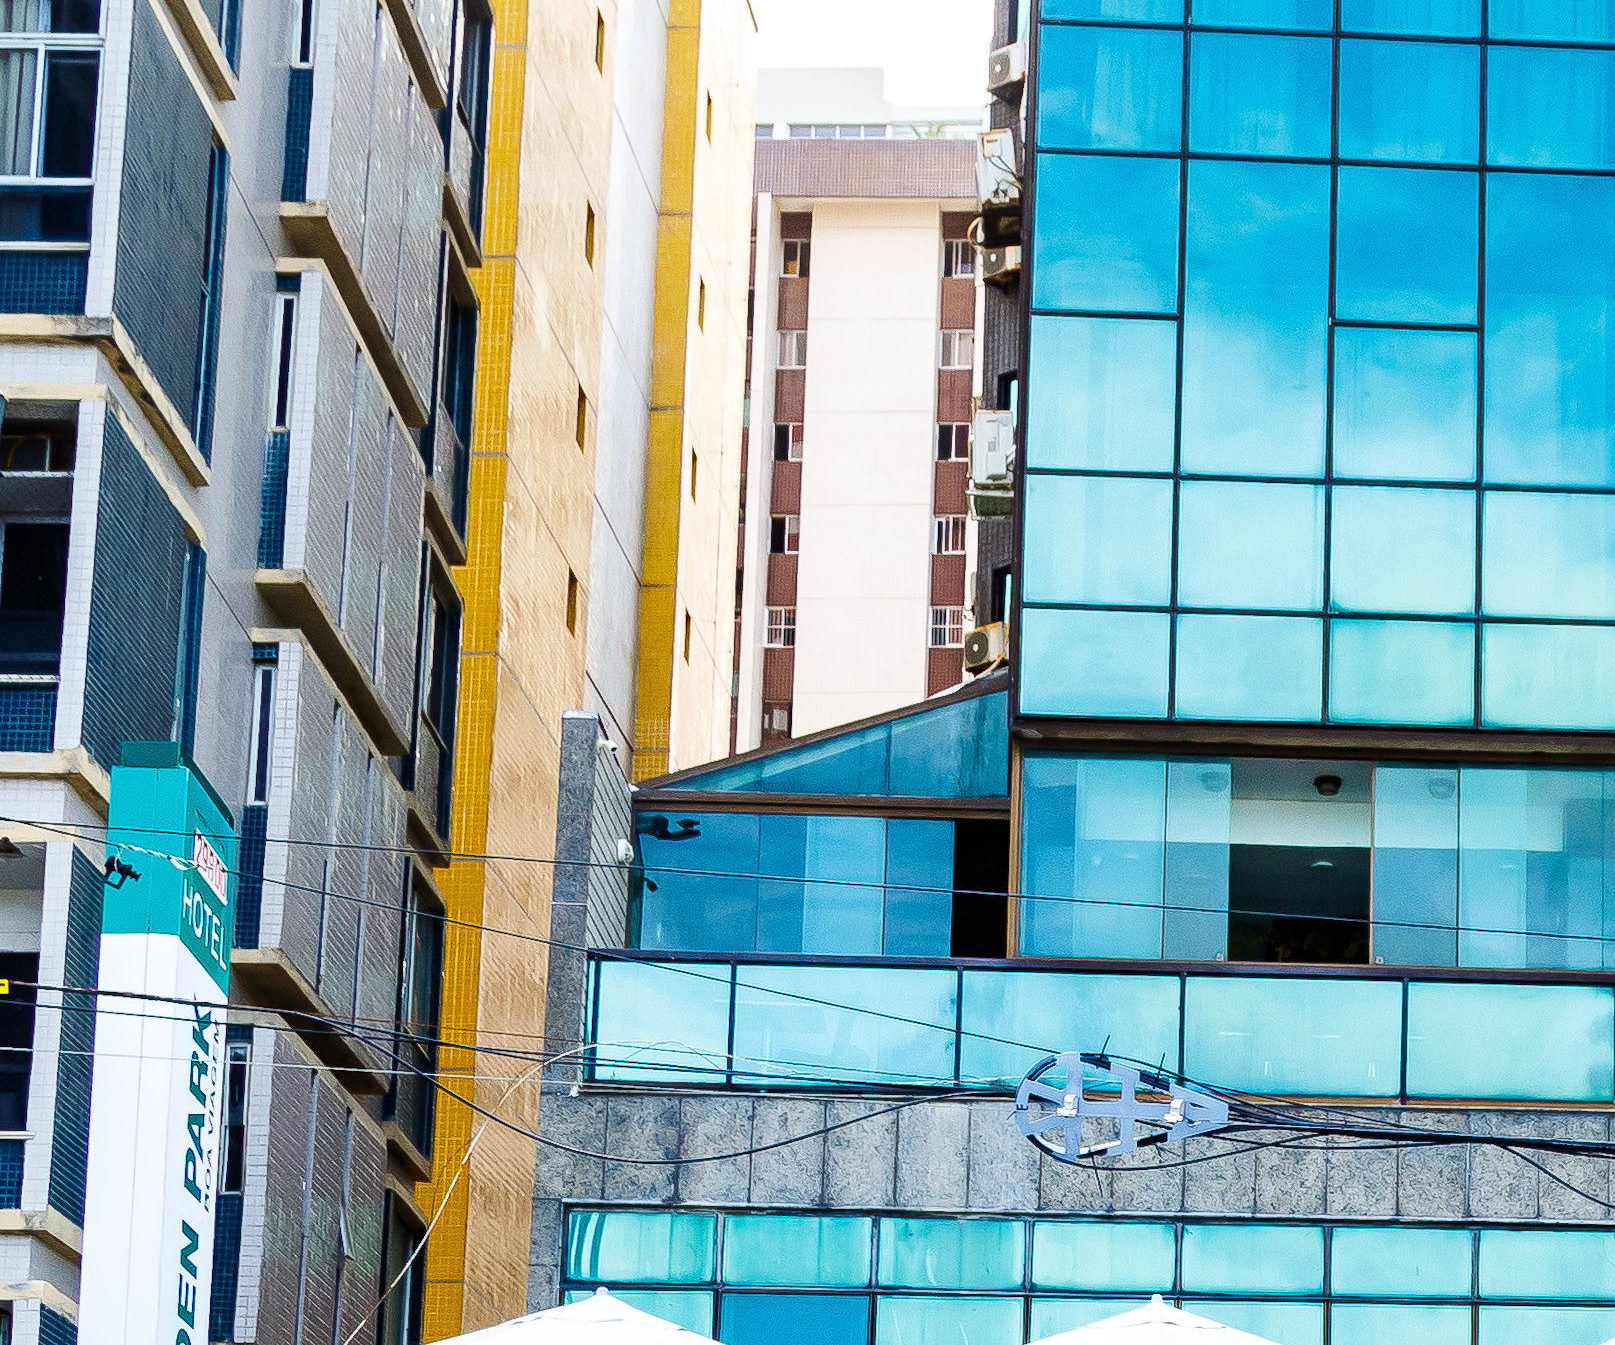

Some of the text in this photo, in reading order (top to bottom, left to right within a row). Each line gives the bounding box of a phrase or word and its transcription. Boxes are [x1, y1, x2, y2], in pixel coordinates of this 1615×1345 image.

[183, 878, 227, 971] HOTEL
[184, 992, 212, 1204] PARK
[203, 1019, 220, 1214] BOA VIAGEM
